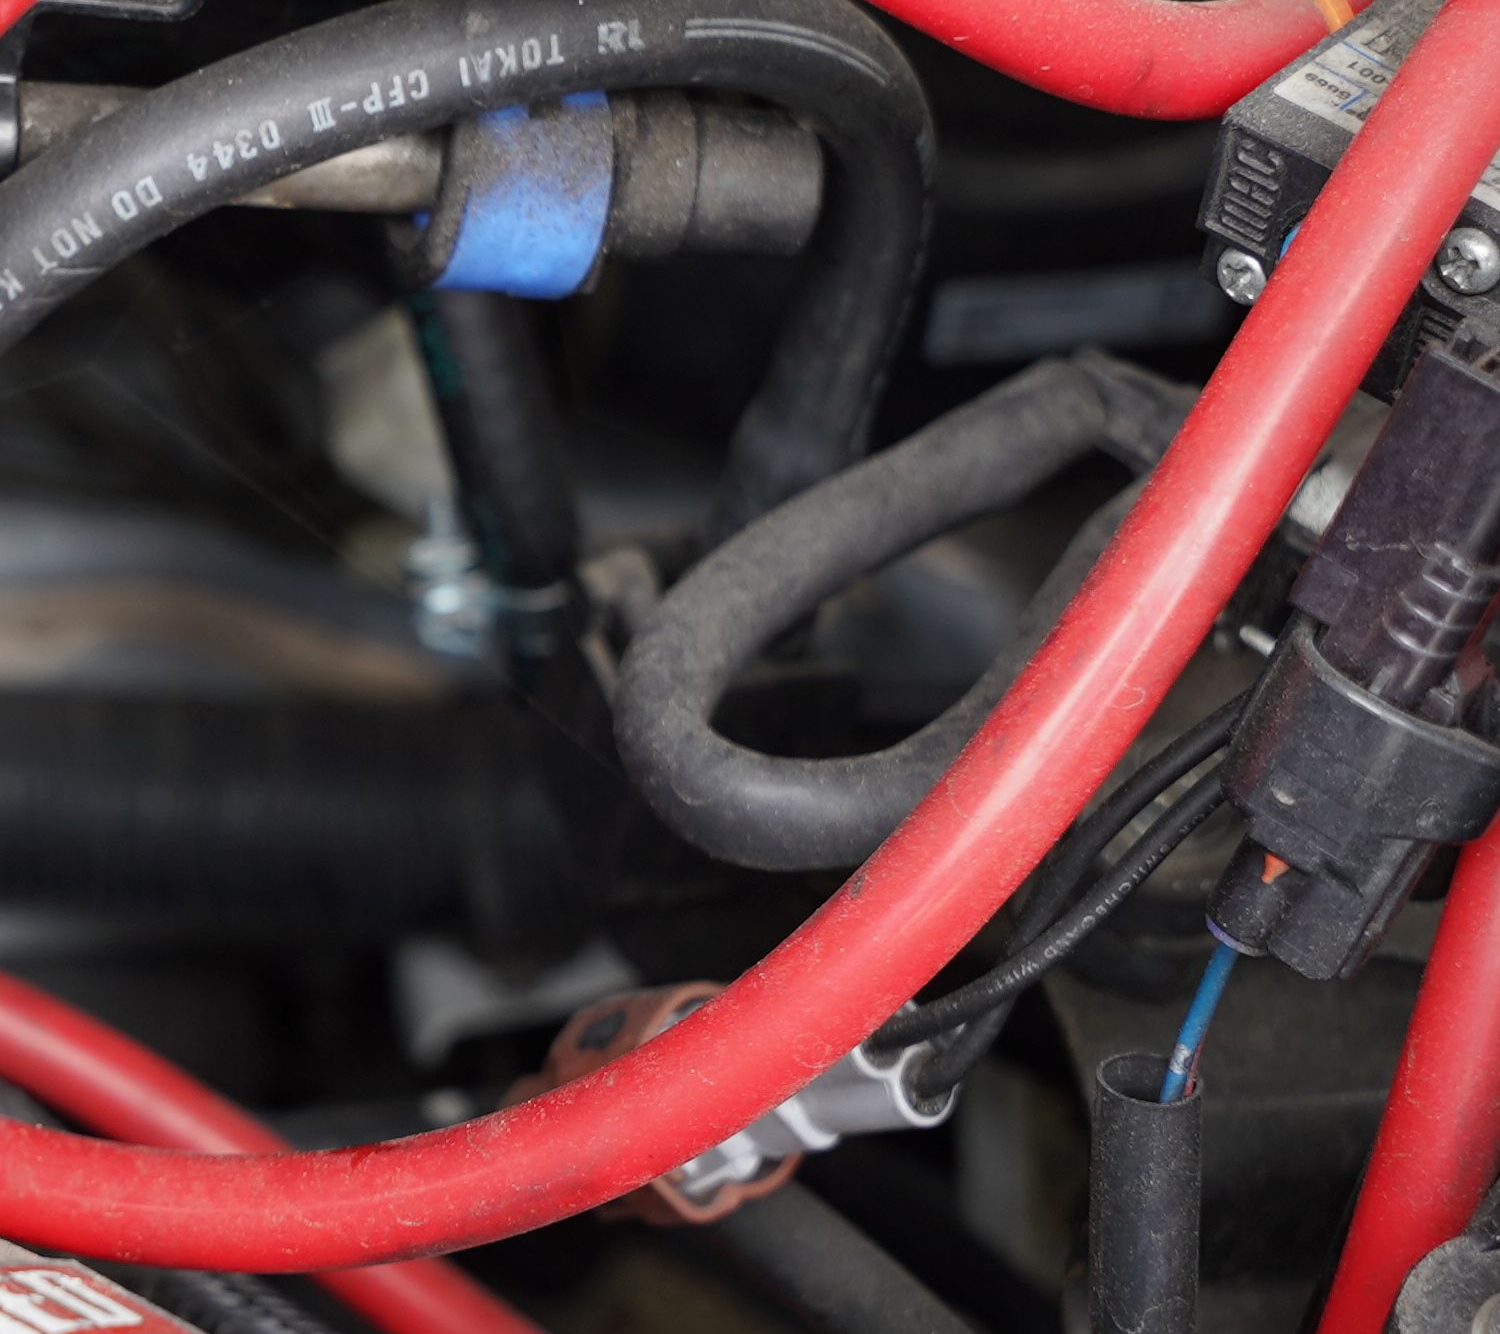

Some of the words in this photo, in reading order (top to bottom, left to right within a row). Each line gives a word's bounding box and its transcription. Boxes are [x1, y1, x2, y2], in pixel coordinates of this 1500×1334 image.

[458, 32, 565, 89] TOKAI
[186, 119, 281, 183] 0344
[110, 176, 164, 223] DO
[31, 216, 104, 275] NOT
